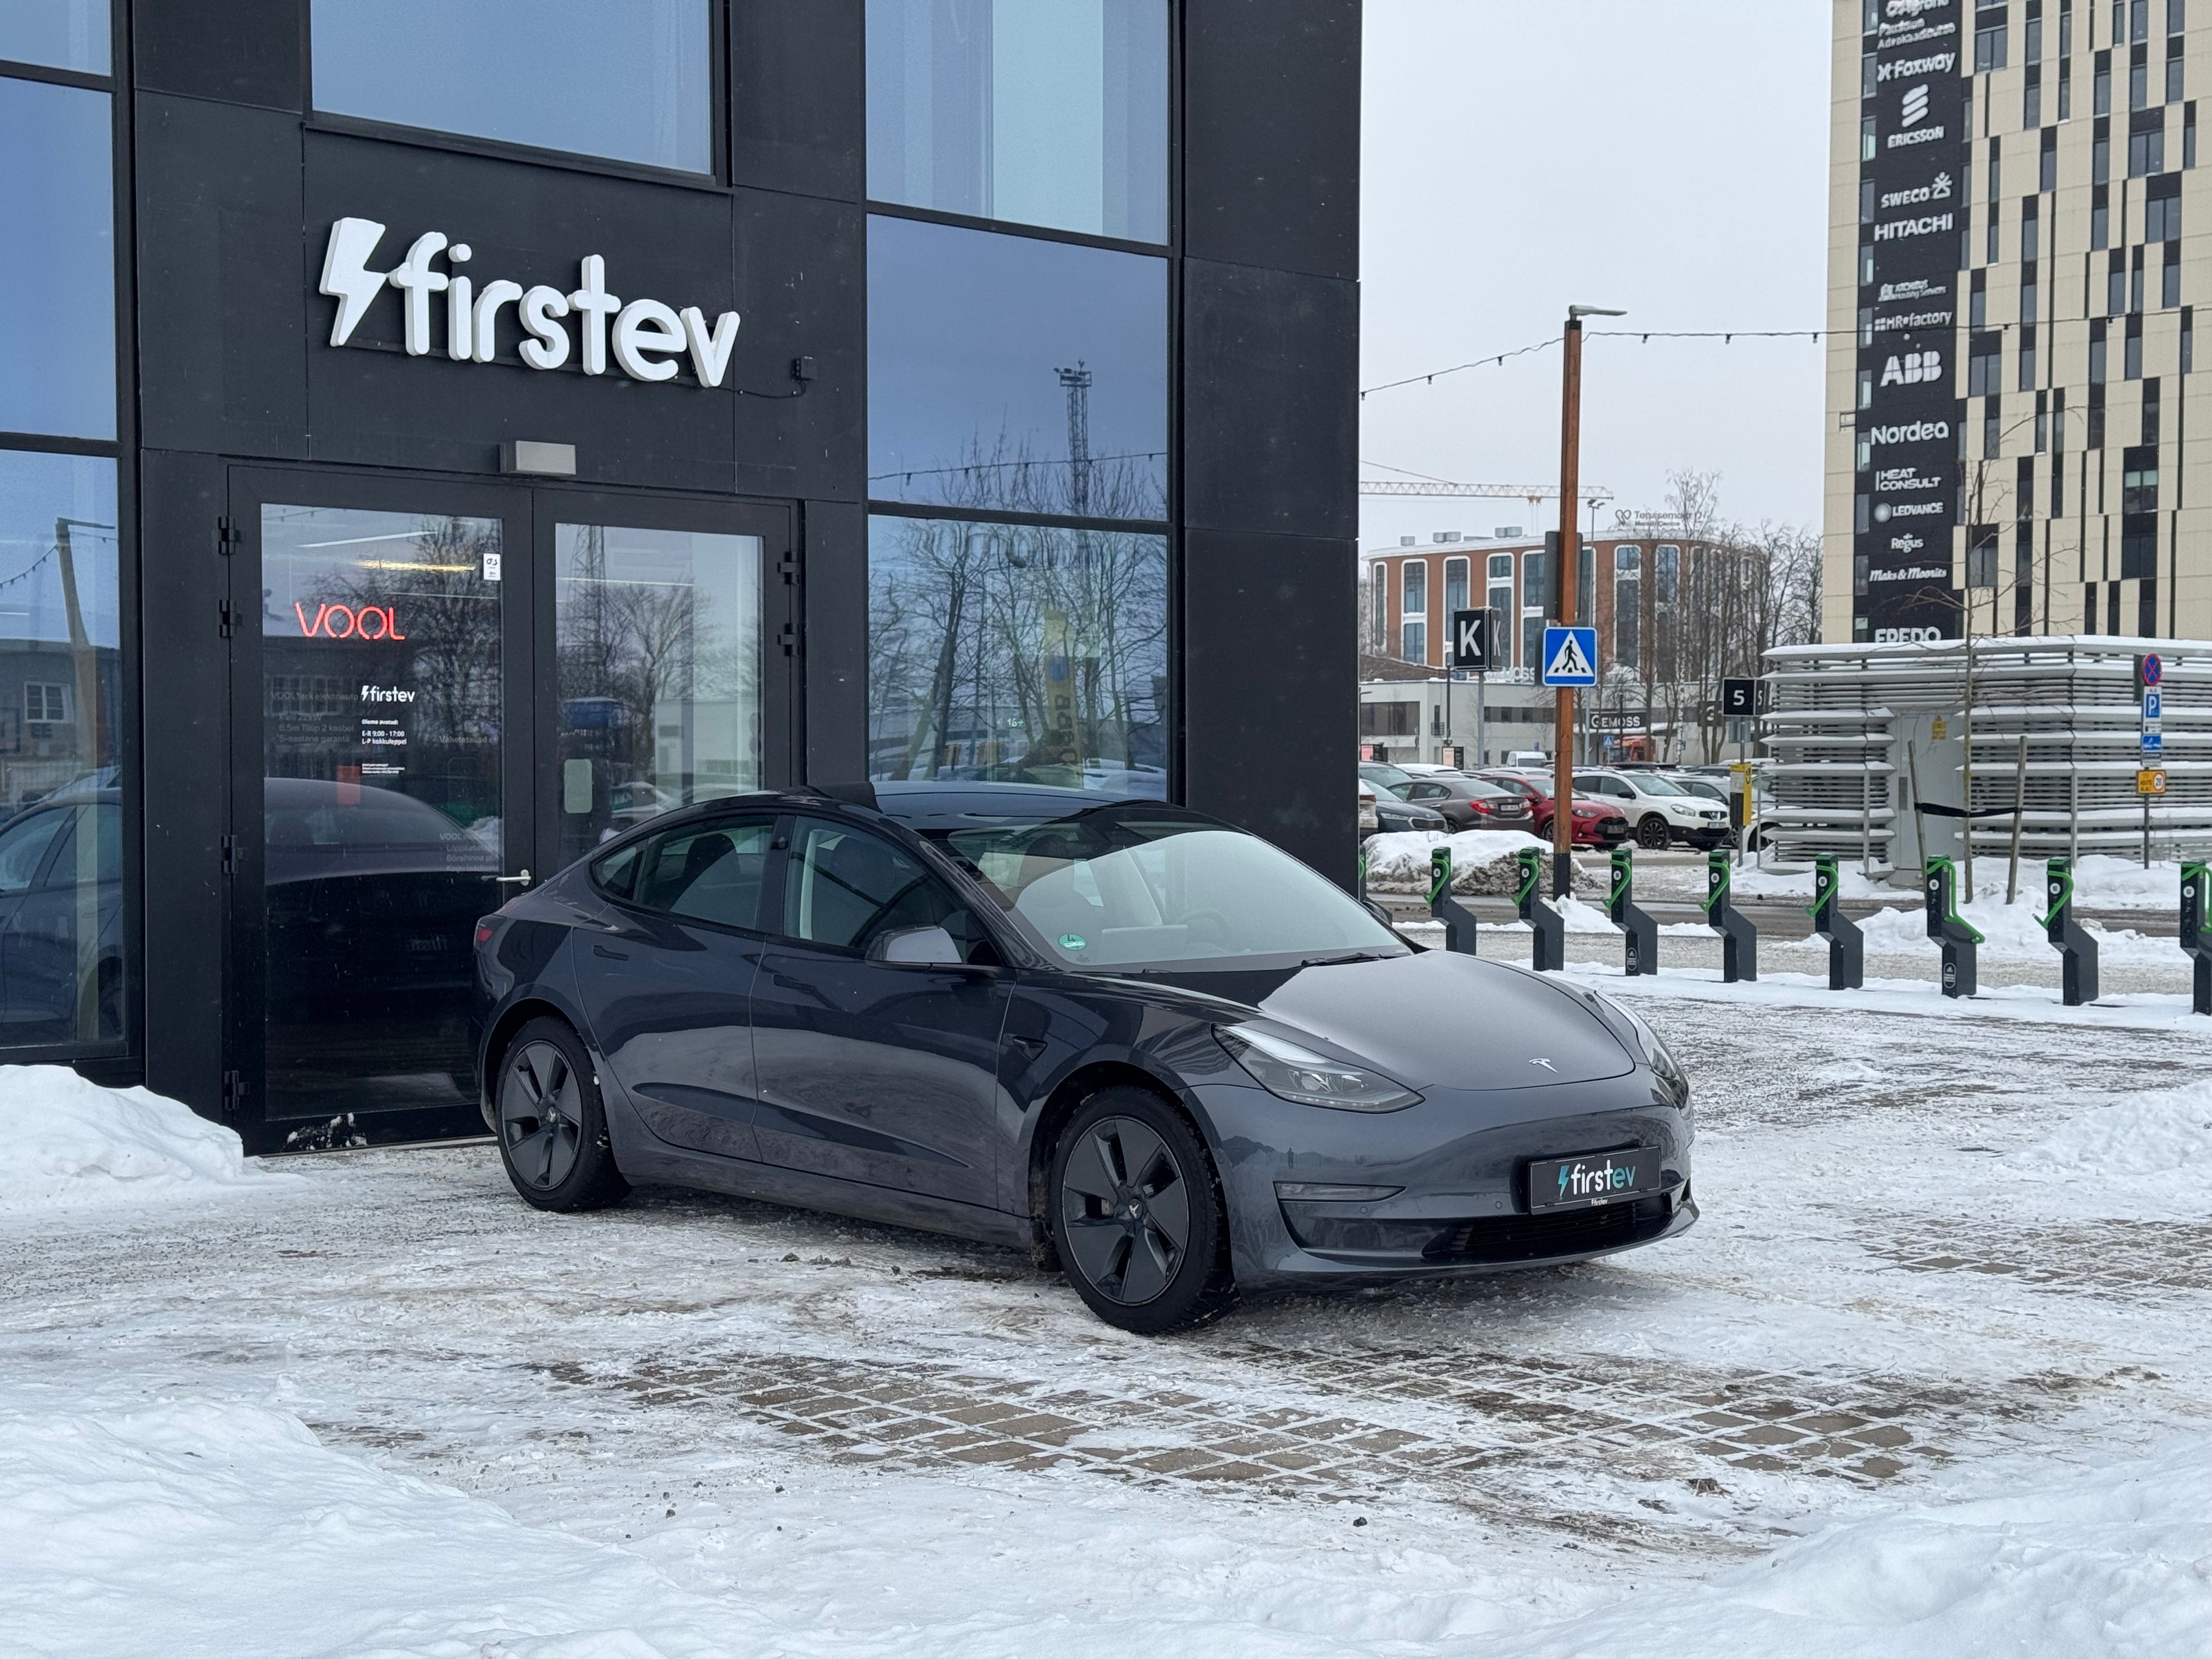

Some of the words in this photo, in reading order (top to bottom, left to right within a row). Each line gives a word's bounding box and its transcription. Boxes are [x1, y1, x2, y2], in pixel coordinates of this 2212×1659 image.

[1894, 52, 1955, 79] Foxway
[1887, 126, 1945, 149] ERICSSON
[1881, 187, 1930, 208] SWECO
[1874, 212, 1953, 242] HITACHI
[388, 231, 741, 388] firstev
[1880, 351, 1942, 387] ABB
[1871, 420, 1949, 445] Nordea
[1880, 476, 1942, 492] CONSULT
[1881, 467, 1917, 481] HEAT
[1893, 502, 1944, 517] LEDVANCE
[1891, 537, 1925, 554] Regus
[1869, 569, 1897, 582] Maks
[1897, 568, 1908, 580] &
[295, 602, 405, 640] VOOL
[1460, 619, 1482, 657] K
[1493, 619, 1501, 657] K
[369, 686, 415, 703] firstev
[1734, 690, 1745, 706] 5
[1758, 690, 1763, 706] 5
[1591, 715, 1640, 728] GEMOSS
[1570, 1159, 1636, 1195] firstev
